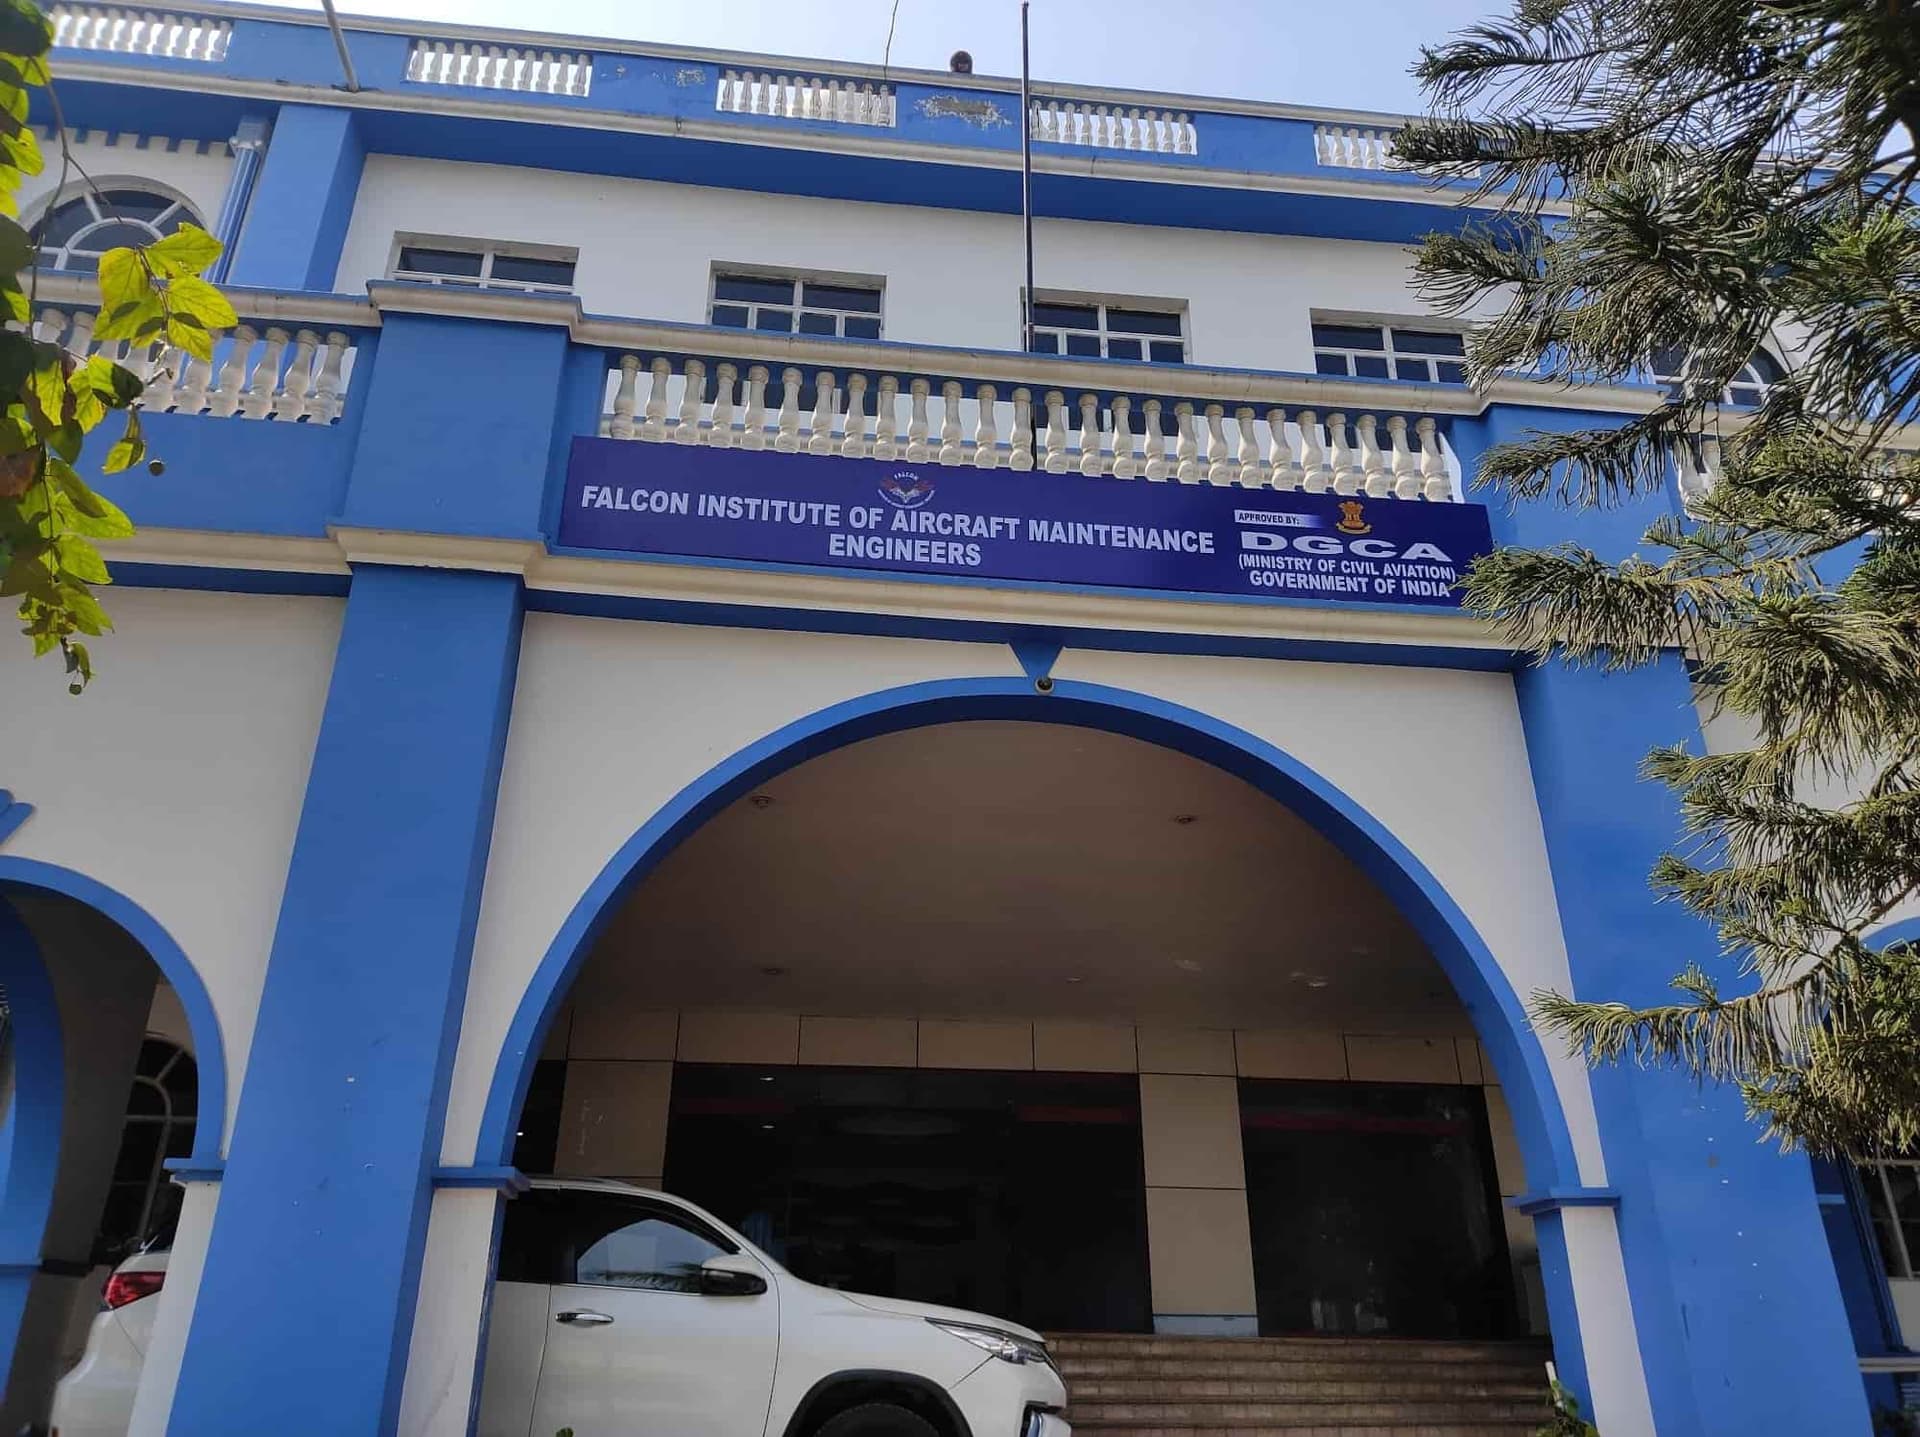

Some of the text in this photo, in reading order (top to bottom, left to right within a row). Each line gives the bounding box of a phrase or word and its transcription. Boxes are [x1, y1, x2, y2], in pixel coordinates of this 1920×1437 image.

[581, 485, 1215, 554] FALCON INSTITUTE OF AIRCRAFT MAINTENANCE
[1238, 512, 1300, 525] APPROVED BY:
[829, 533, 982, 566] ENGINEERS
[1241, 531, 1452, 562] DGCA
[1238, 554, 1456, 583] (MINISTRY OF CIVIL AVIATION)
[1249, 569, 1450, 598] GOVERNMENT OF INDIA
